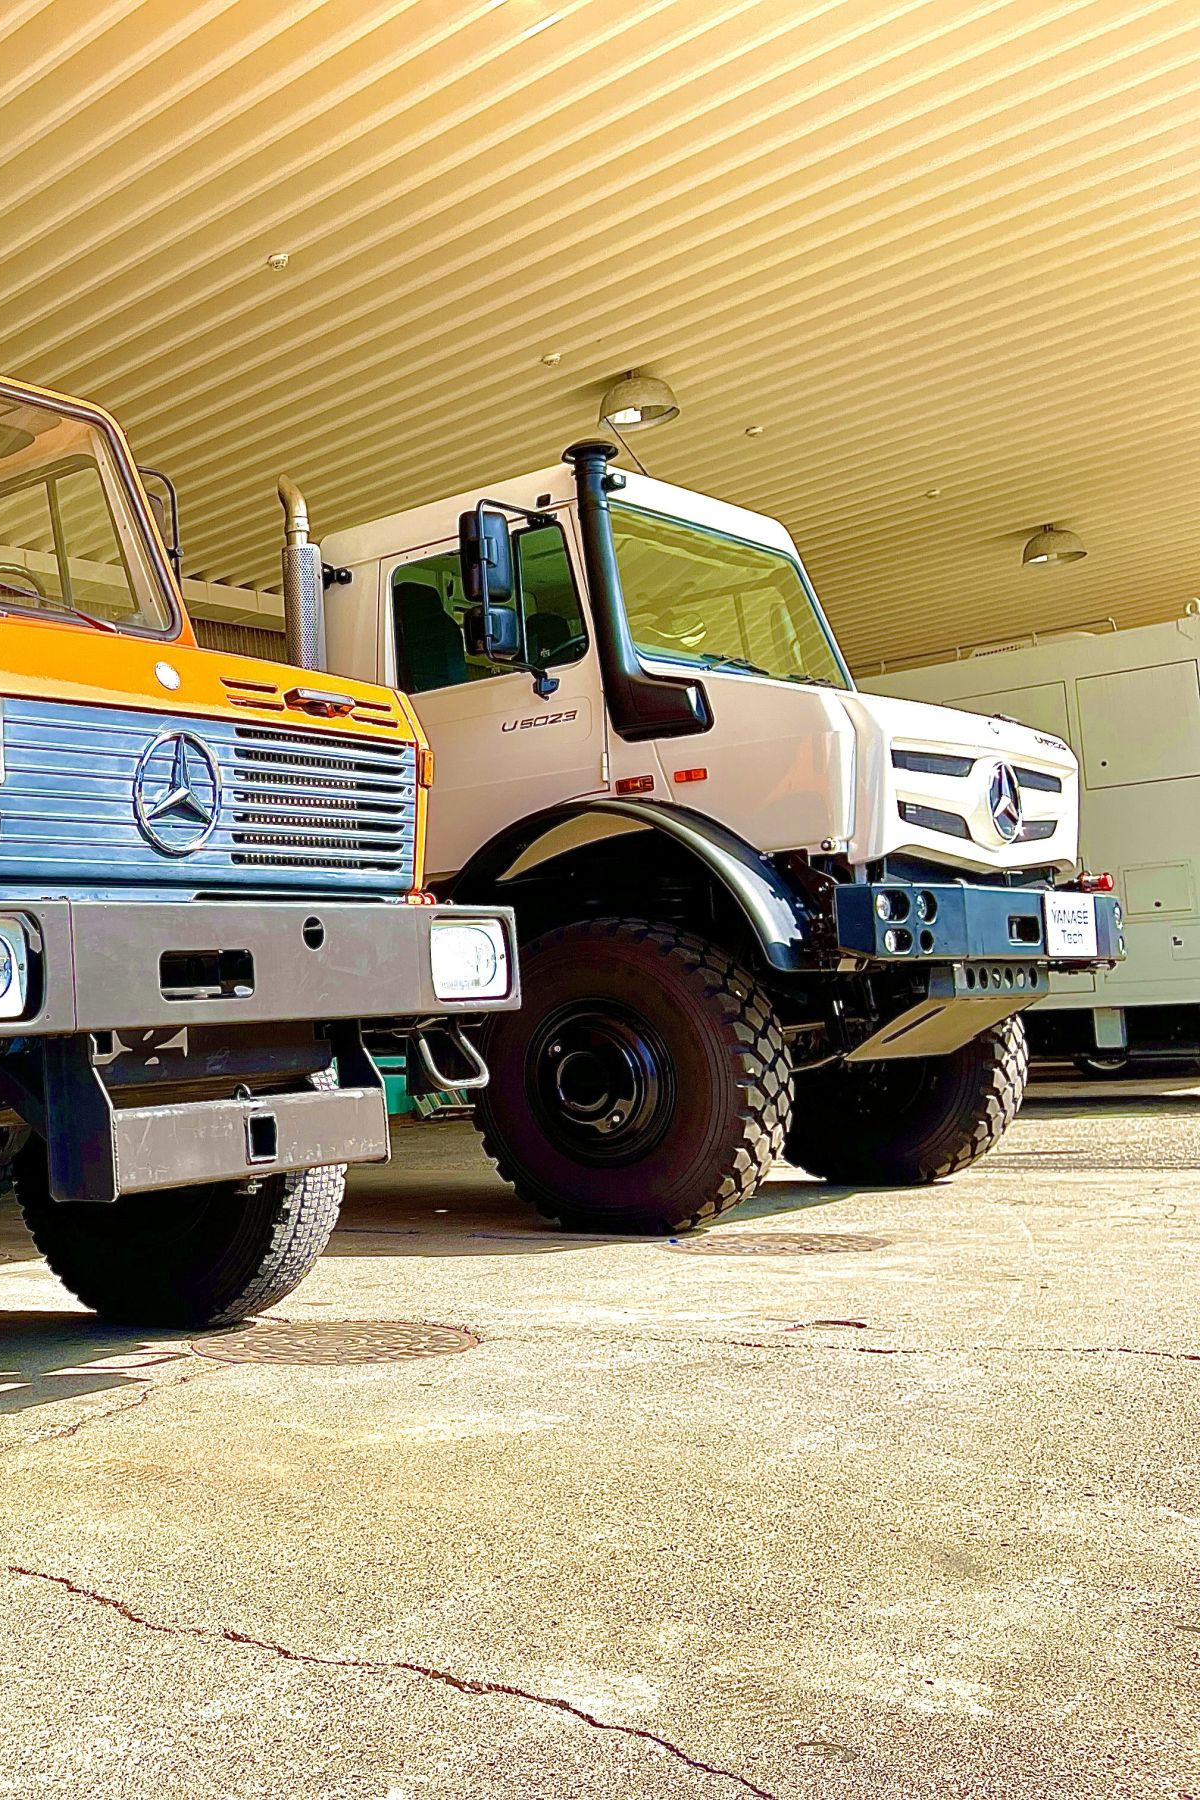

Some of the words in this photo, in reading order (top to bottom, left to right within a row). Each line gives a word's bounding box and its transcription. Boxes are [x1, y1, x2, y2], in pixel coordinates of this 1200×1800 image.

[501, 720, 518, 732] U
[520, 710, 578, 729] 5023
[1051, 909, 1089, 925] YANASE
[1061, 929, 1084, 945] Tech
